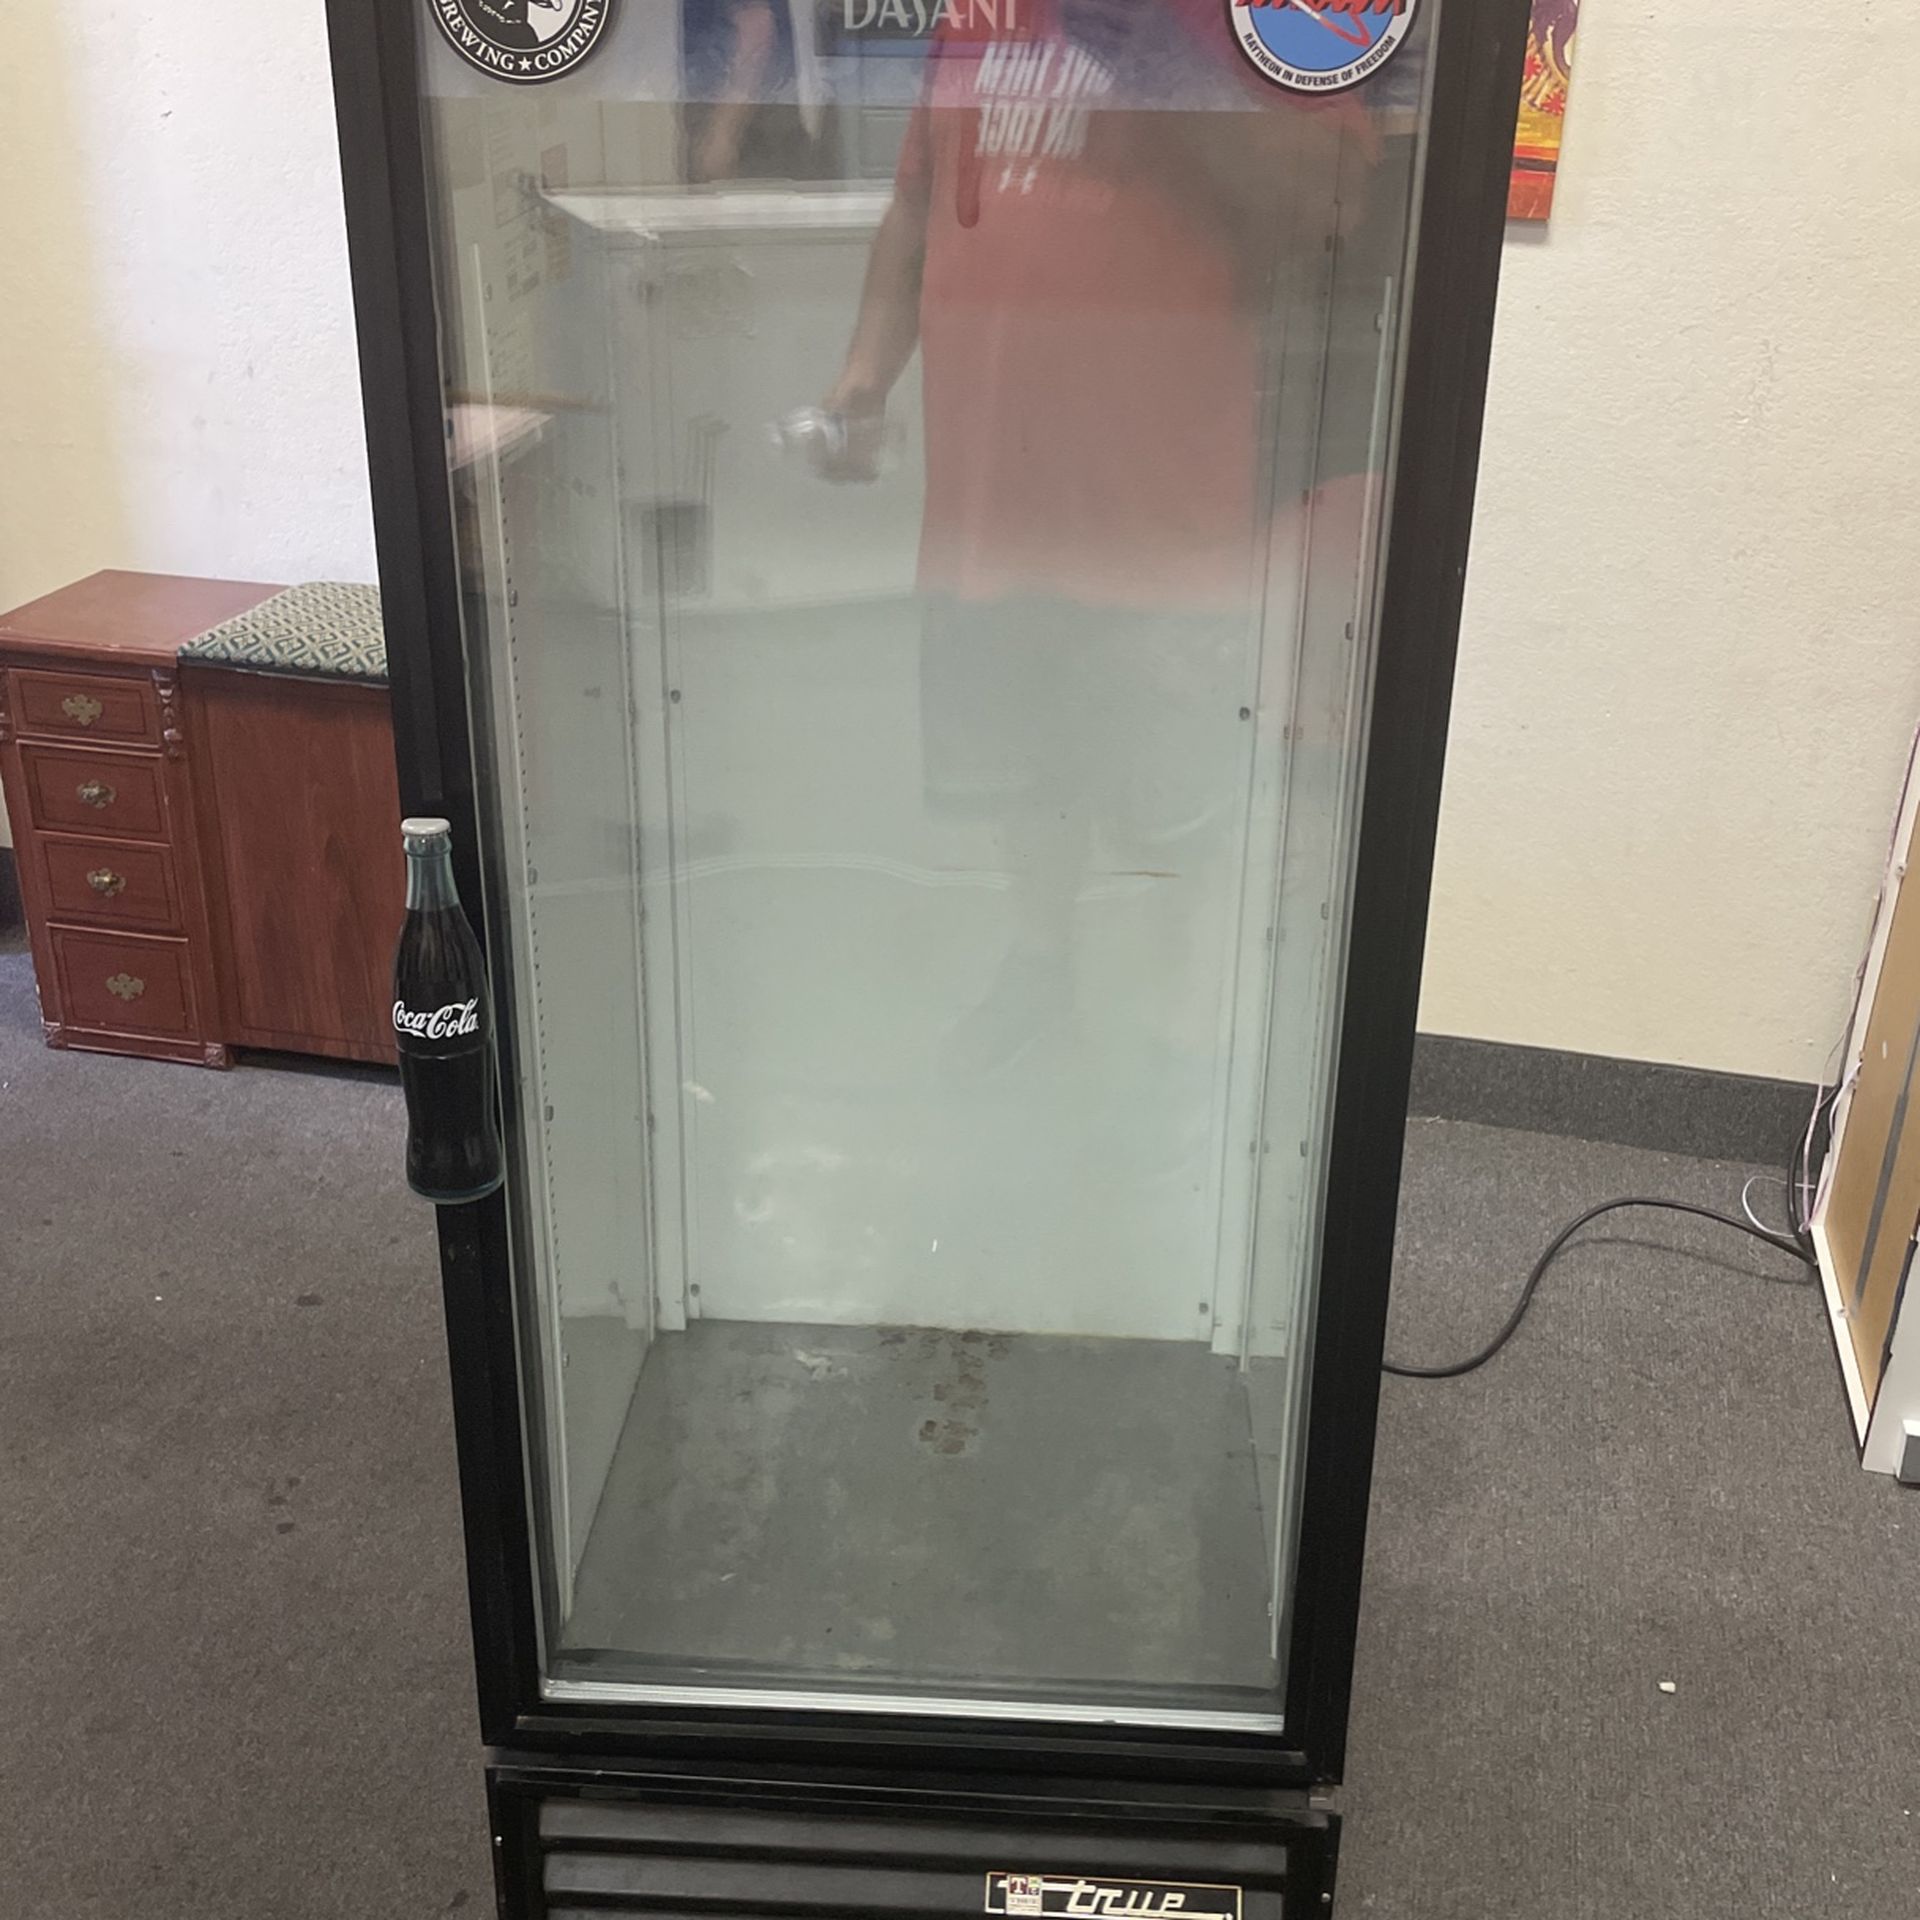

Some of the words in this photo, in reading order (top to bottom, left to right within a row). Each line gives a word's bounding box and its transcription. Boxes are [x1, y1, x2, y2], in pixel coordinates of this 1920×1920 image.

[534, 0, 602, 71] COMPAN
[1243, 32, 1283, 76] RAYTHEON
[1282, 69, 1294, 81] IN
[1294, 73, 1340, 87] DEFENSE
[1341, 68, 1354, 81] OF
[1354, 35, 1397, 75] FREEDOM
[392, 997, 479, 1039] Coca-Cola
[1066, 1879, 1187, 1917] true
